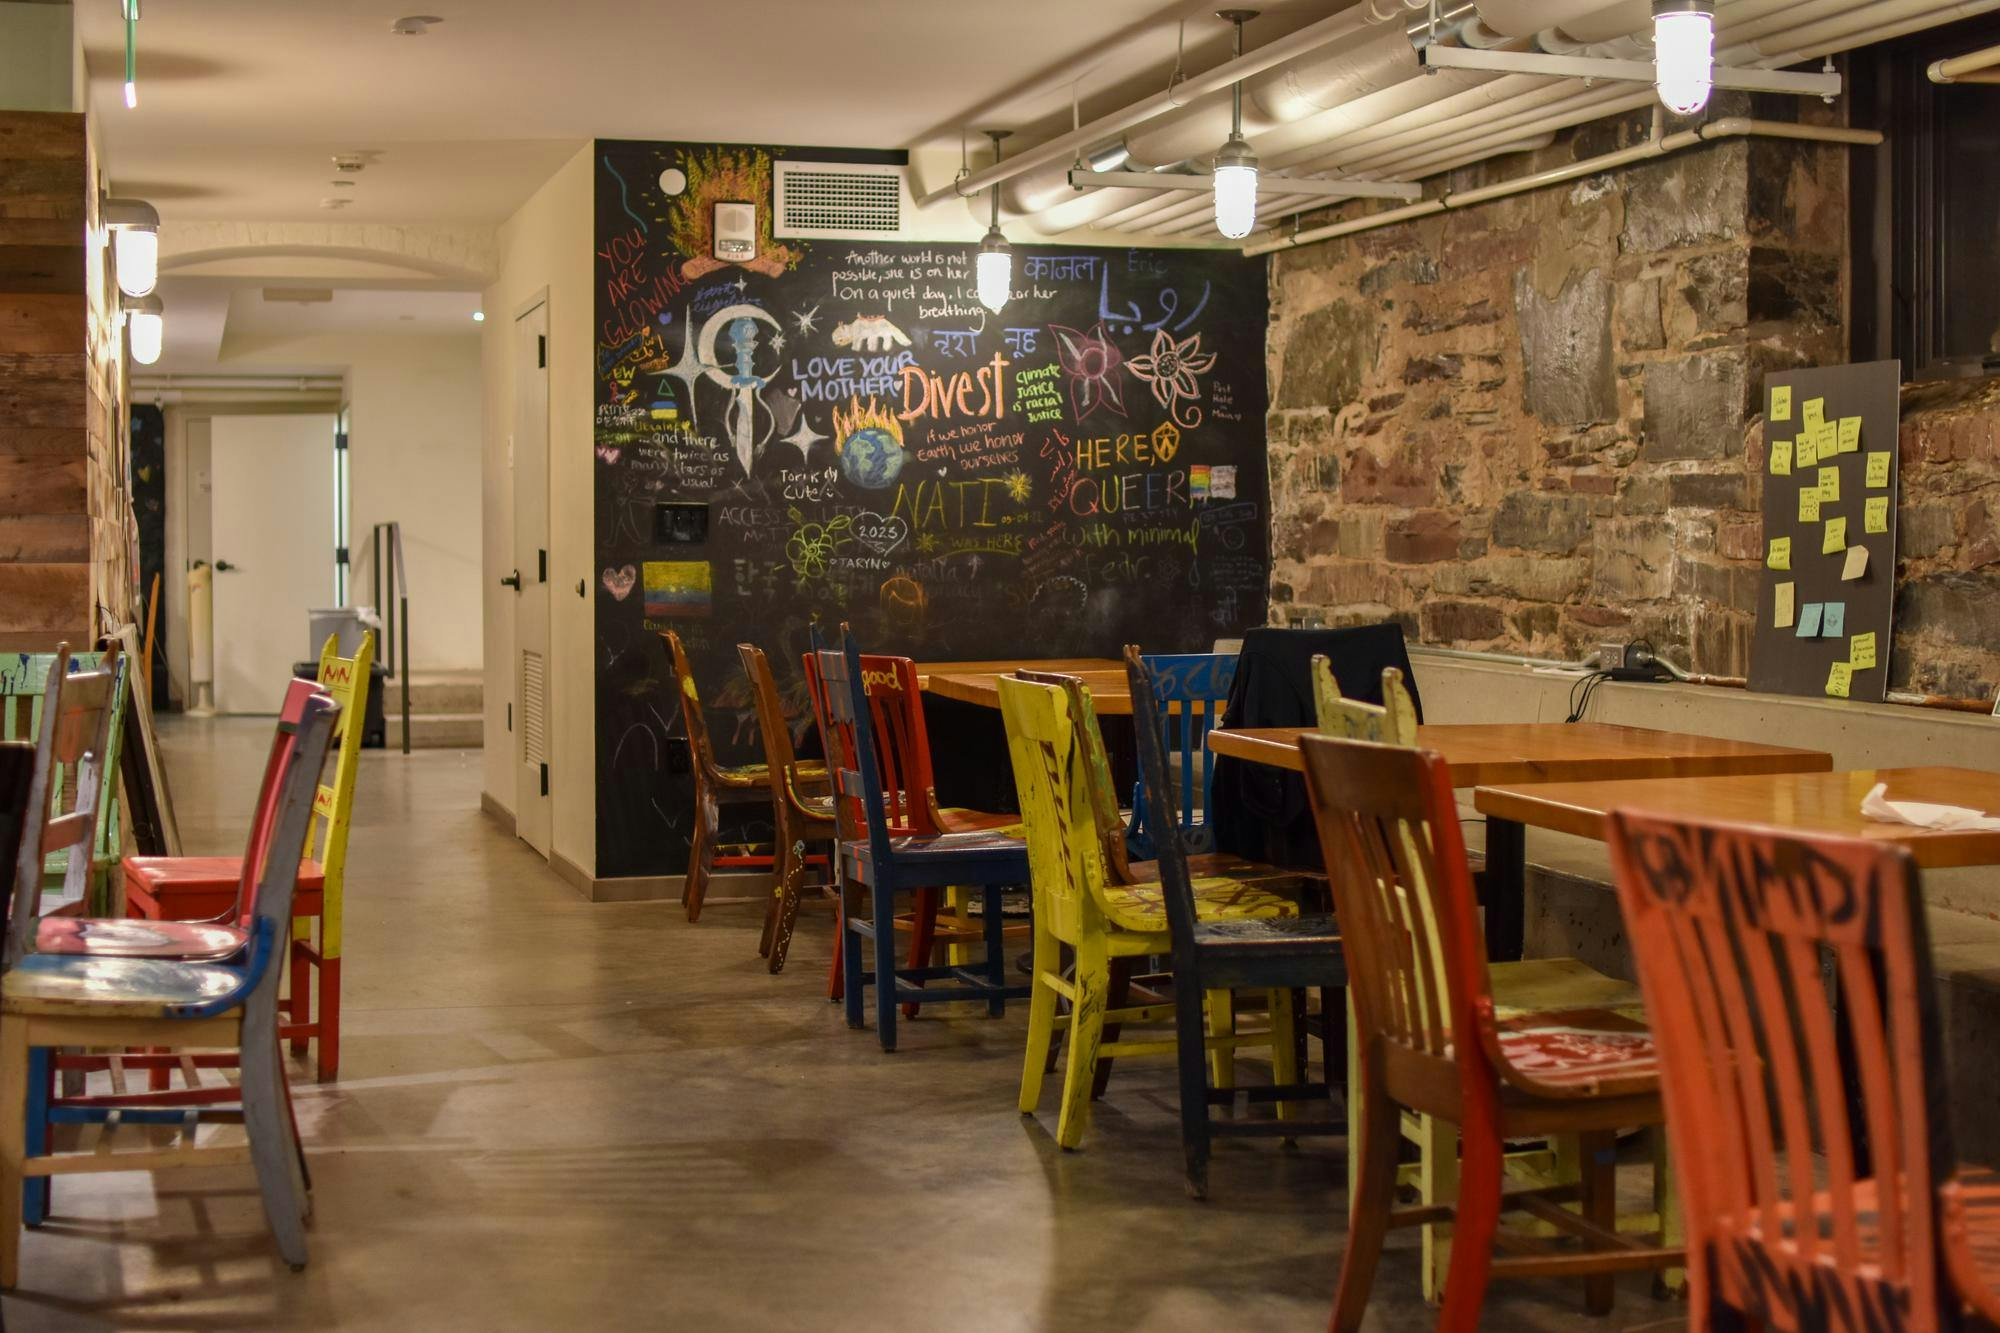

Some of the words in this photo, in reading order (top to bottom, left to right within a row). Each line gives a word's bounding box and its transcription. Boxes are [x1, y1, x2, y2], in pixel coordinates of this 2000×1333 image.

[597, 227, 647, 275] YOU
[845, 250, 896, 265] Another
[901, 250, 932, 264] world
[935, 252, 944, 264] is
[947, 251, 968, 265] not
[608, 252, 647, 306] ARE
[883, 266, 904, 279] she
[926, 267, 943, 278] on
[947, 266, 970, 280] her
[839, 286, 863, 300] On
[867, 287, 879, 300] a
[883, 285, 916, 312] quiet
[1033, 285, 1058, 300] her
[792, 356, 856, 380] LOVE
[859, 350, 919, 378] YOUR
[1016, 363, 1061, 385] Climate
[800, 375, 898, 402] MOTHER
[1013, 401, 1022, 412] is
[1026, 392, 1063, 409] racial
[682, 430, 720, 449] there
[938, 430, 959, 442] we
[960, 422, 998, 437] honor
[638, 447, 668, 458] were
[672, 447, 708, 461] twice
[713, 452, 729, 462] as
[916, 444, 957, 462] Earth
[959, 440, 982, 454] we
[985, 432, 1025, 448] honor
[631, 460, 669, 477] many
[960, 449, 1020, 470] ourselves
[840, 557, 882, 570] TARYN
[861, 661, 904, 696] good
